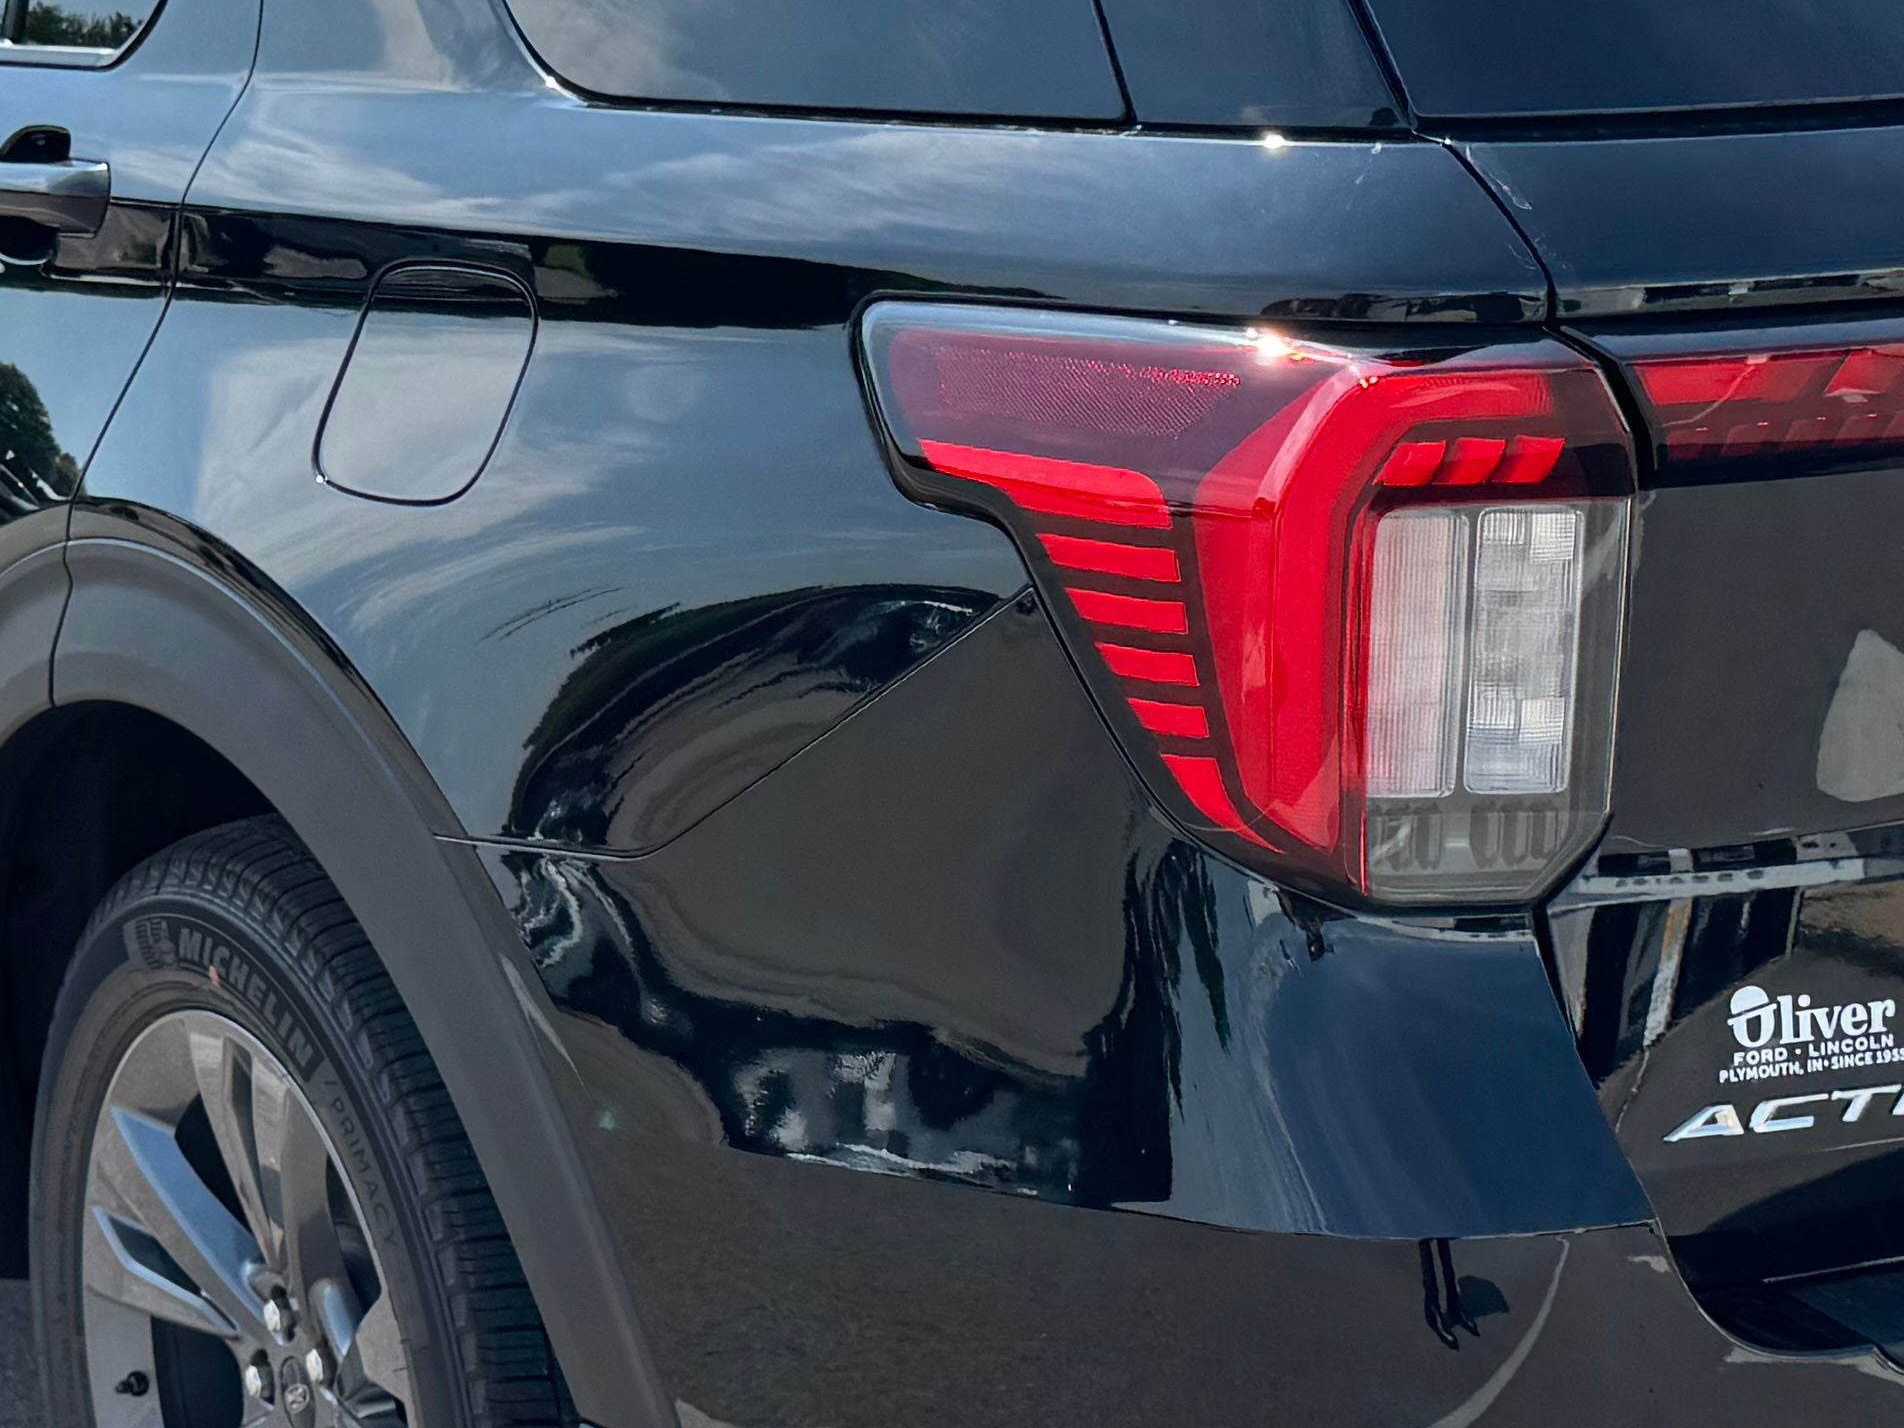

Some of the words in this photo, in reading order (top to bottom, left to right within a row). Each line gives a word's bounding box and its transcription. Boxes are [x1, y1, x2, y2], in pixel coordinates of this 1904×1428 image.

[179, 928, 315, 1070] MICHELIN
[1727, 985, 1896, 1048] Oliver
[1718, 1060, 1804, 1084] PLYMOUTH,
[1733, 1047, 1788, 1066] FORD
[1808, 1034, 1895, 1057] LINCOLN
[332, 1097, 399, 1250] PRIMACY
